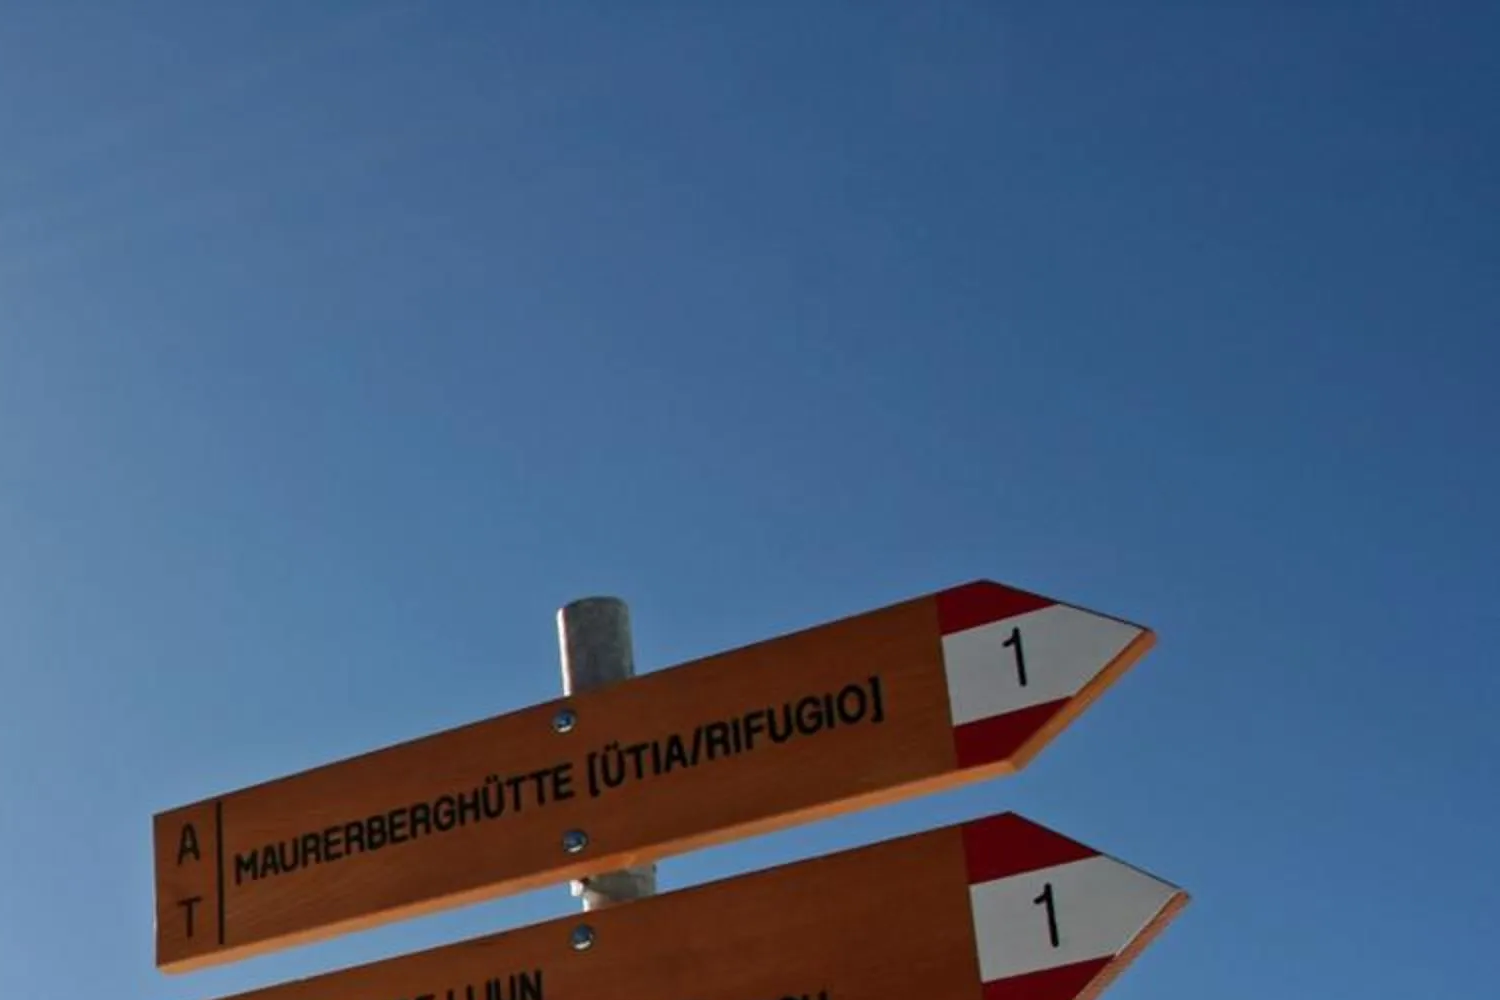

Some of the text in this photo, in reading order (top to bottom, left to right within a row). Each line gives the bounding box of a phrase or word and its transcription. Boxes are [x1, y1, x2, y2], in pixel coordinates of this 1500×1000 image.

[1001, 626, 1026, 687] 1
[177, 823, 200, 865] A
[233, 762, 575, 885] MAURERBERGHÜTTE
[178, 896, 203, 938] T
[1033, 883, 1059, 948] 1
